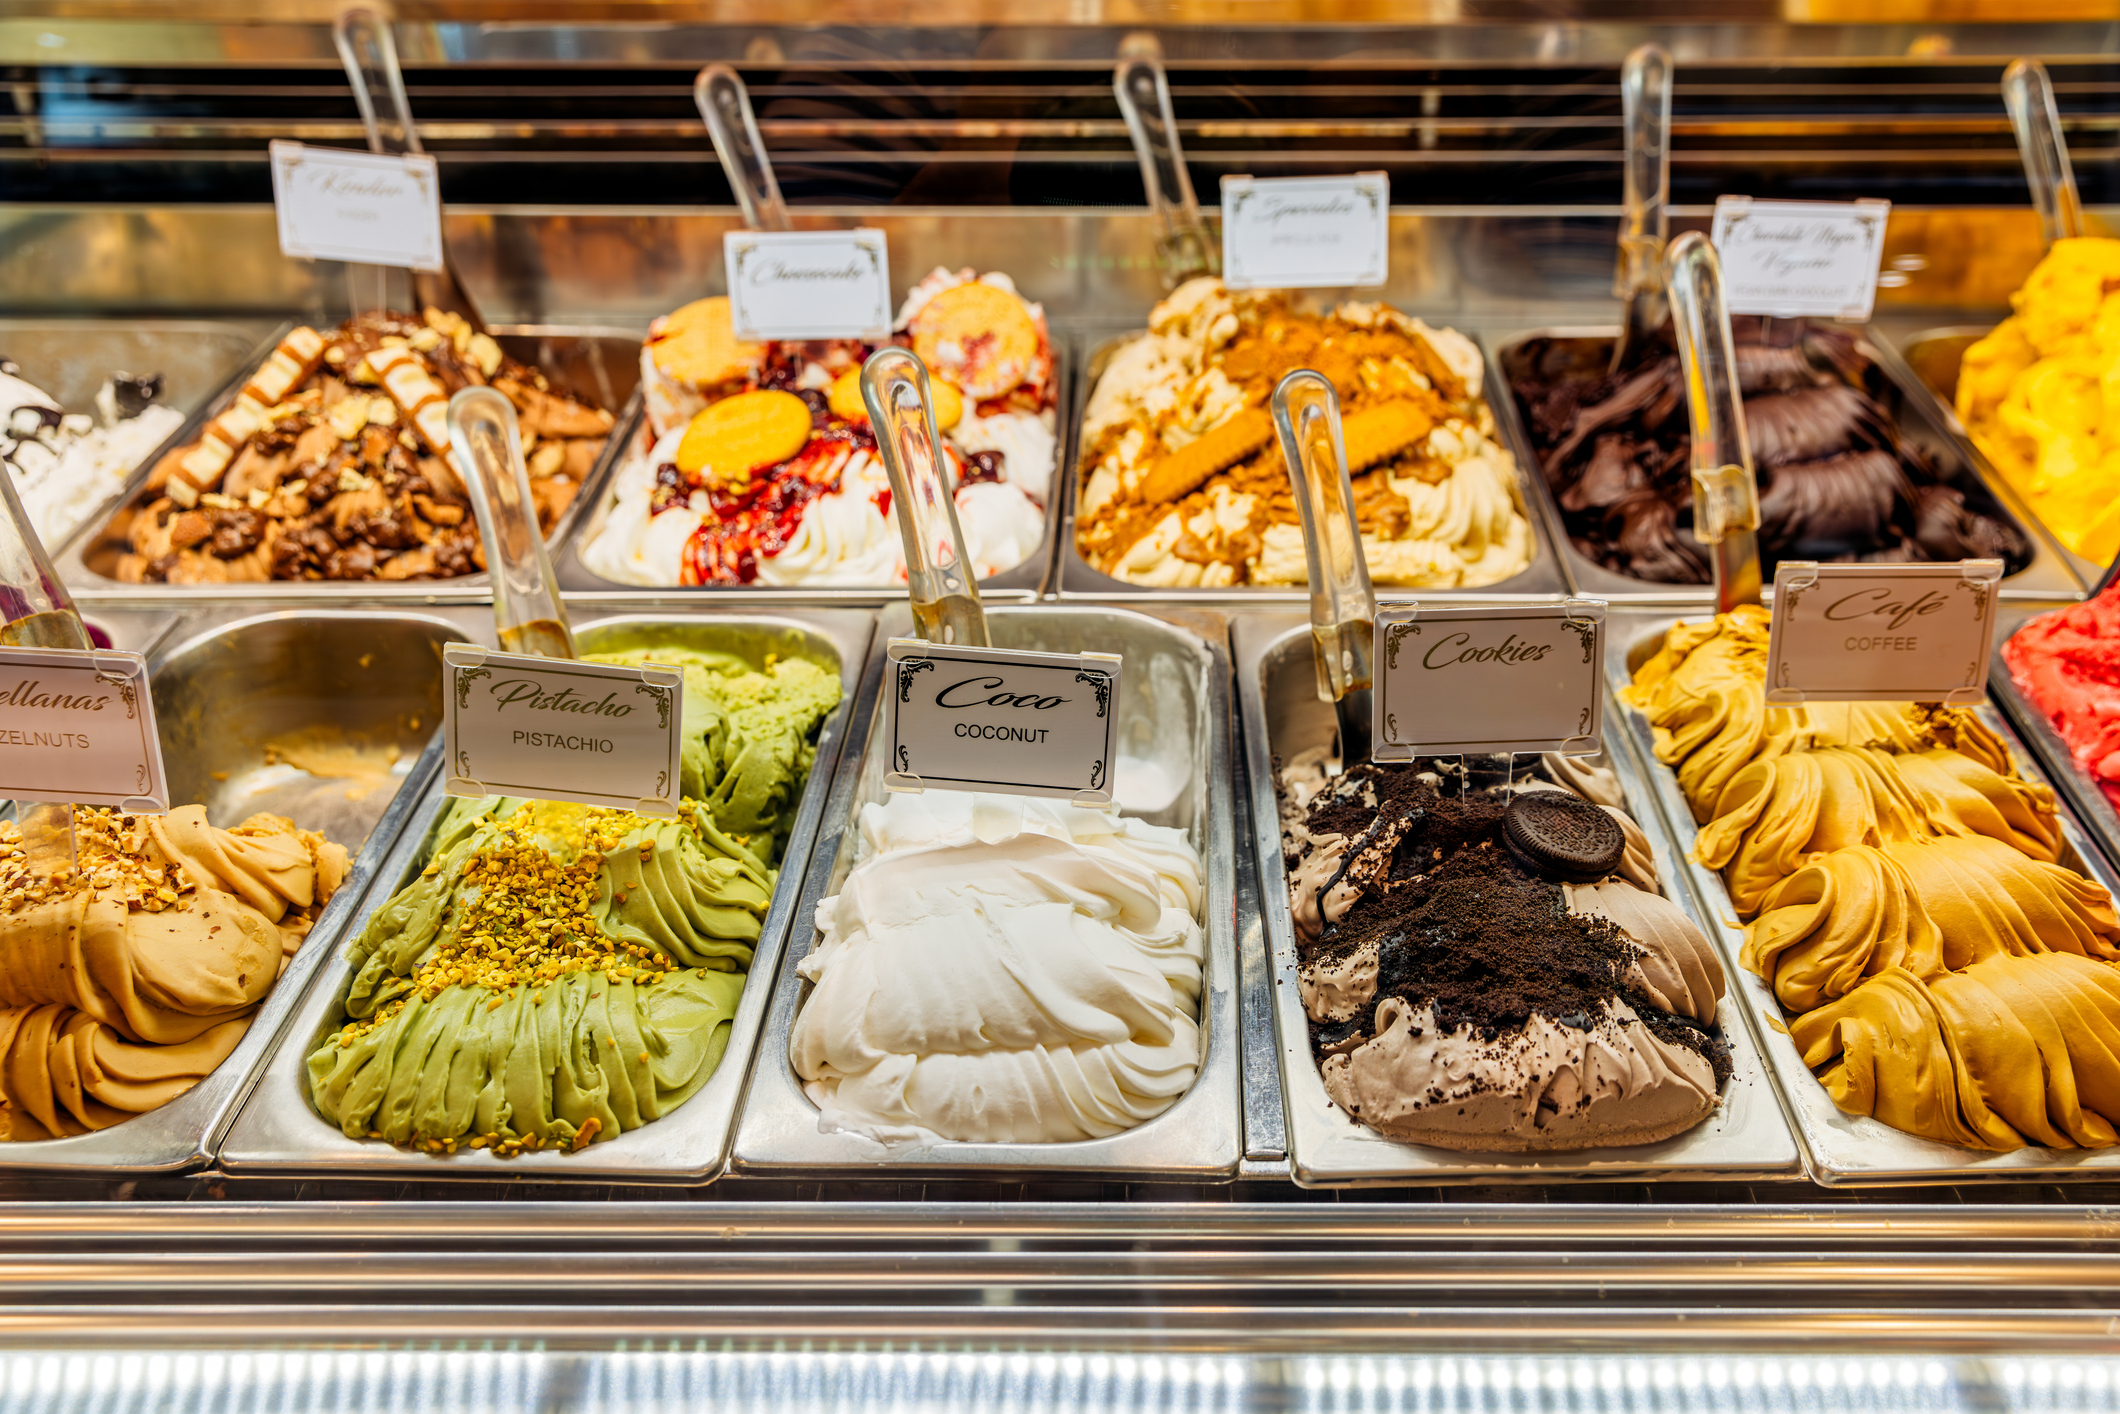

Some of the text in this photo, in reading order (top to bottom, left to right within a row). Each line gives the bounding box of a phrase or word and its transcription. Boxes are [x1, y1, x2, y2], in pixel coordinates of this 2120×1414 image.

[1824, 587, 1949, 631] Café
[1422, 632, 1555, 670] Cookies
[1844, 636, 1917, 651] COFFEE
[489, 679, 638, 718] Pistacho
[935, 676, 1073, 709] Coco
[512, 730, 614, 754] PISTACHIO
[954, 723, 1049, 743] COCONUT
